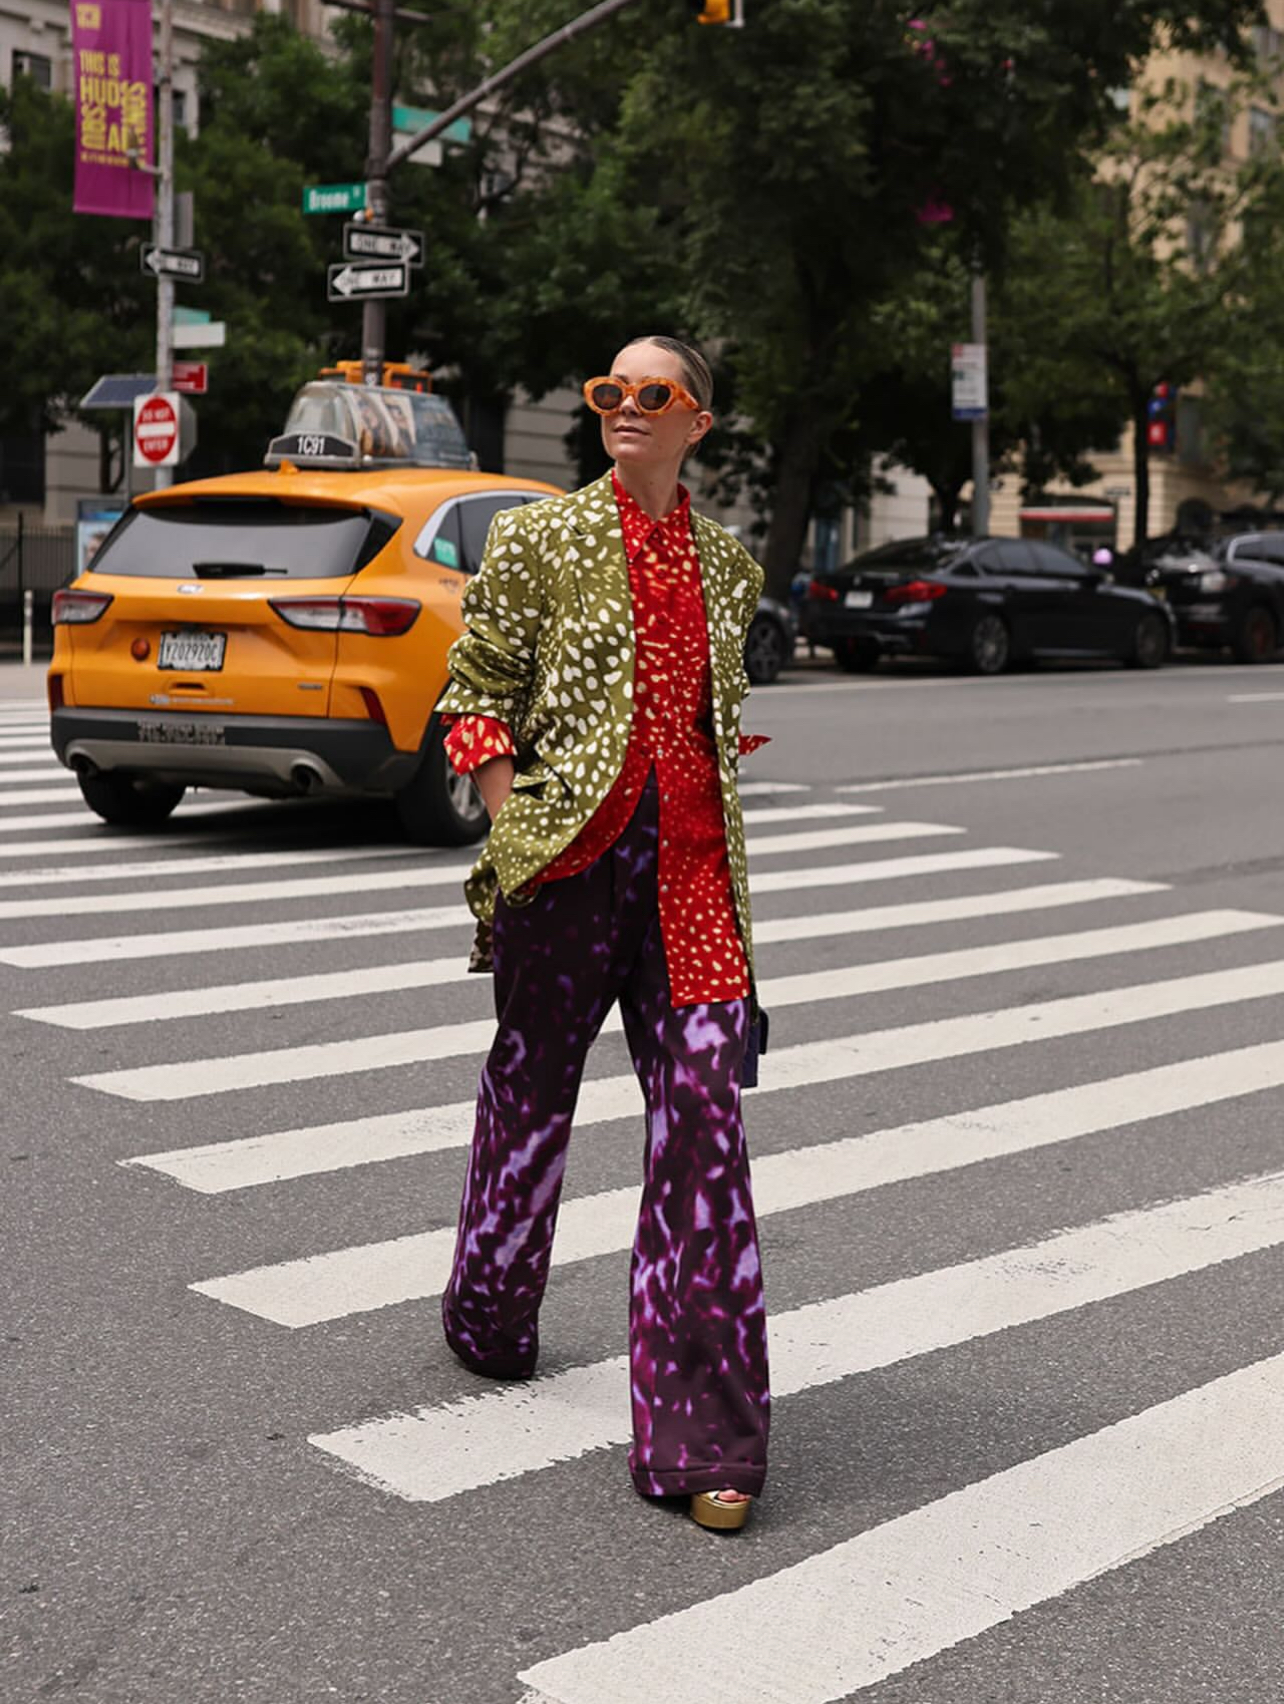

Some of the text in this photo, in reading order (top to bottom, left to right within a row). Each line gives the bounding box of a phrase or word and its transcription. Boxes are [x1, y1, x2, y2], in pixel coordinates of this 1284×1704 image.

[309, 189, 349, 211] Broome
[372, 271, 396, 286] WAY
[143, 438, 169, 453] ENTER
[297, 436, 326, 455] 1C91
